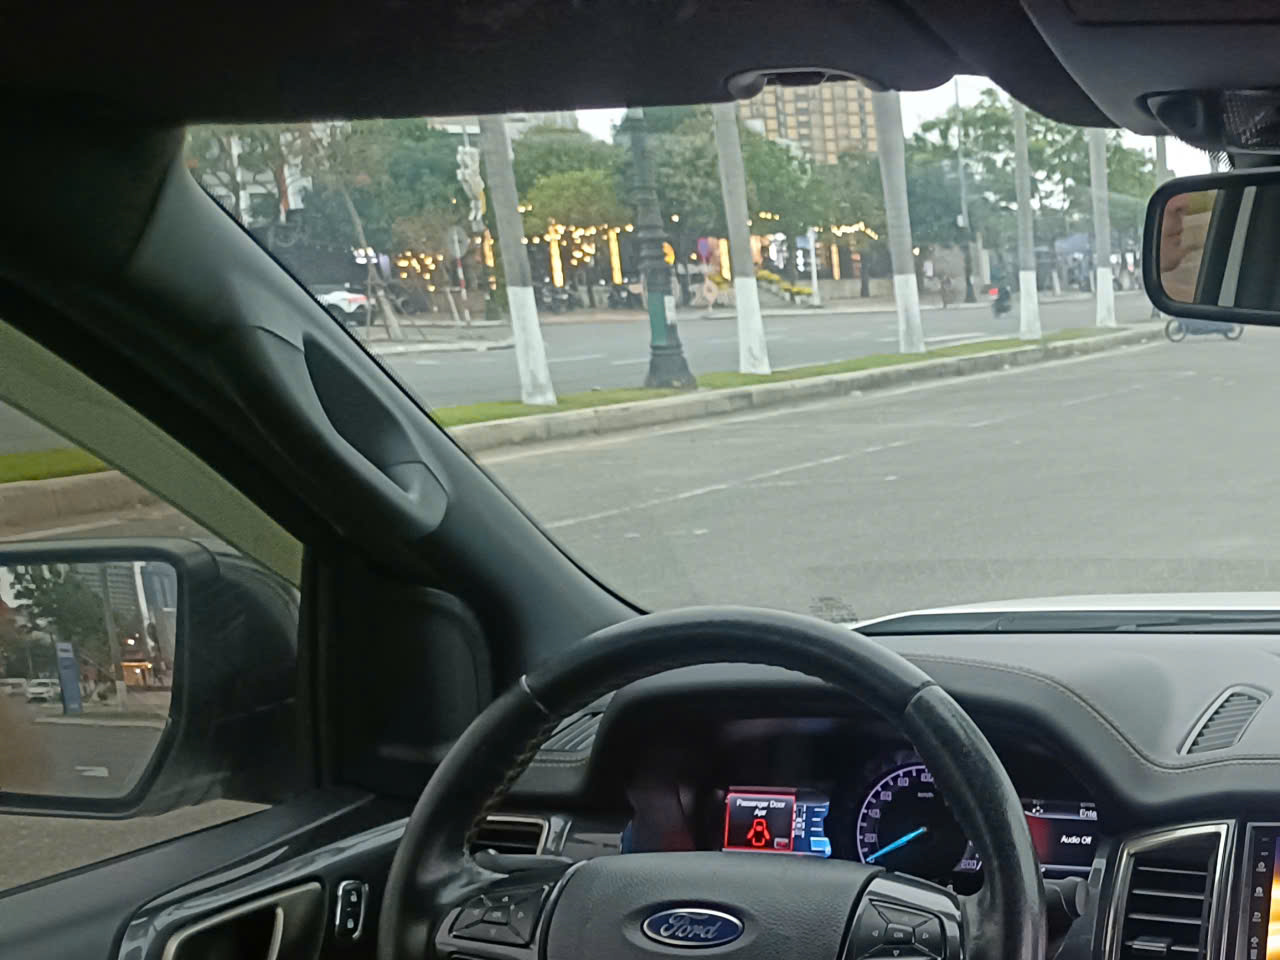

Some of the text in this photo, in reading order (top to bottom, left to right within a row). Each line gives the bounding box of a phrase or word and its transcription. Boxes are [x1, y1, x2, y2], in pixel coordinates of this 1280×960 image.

[736, 799, 786, 808] Passenger Door
[864, 833, 876, 843] 20
[1060, 835, 1092, 845] Audio Off
[660, 912, 722, 939] Ford
